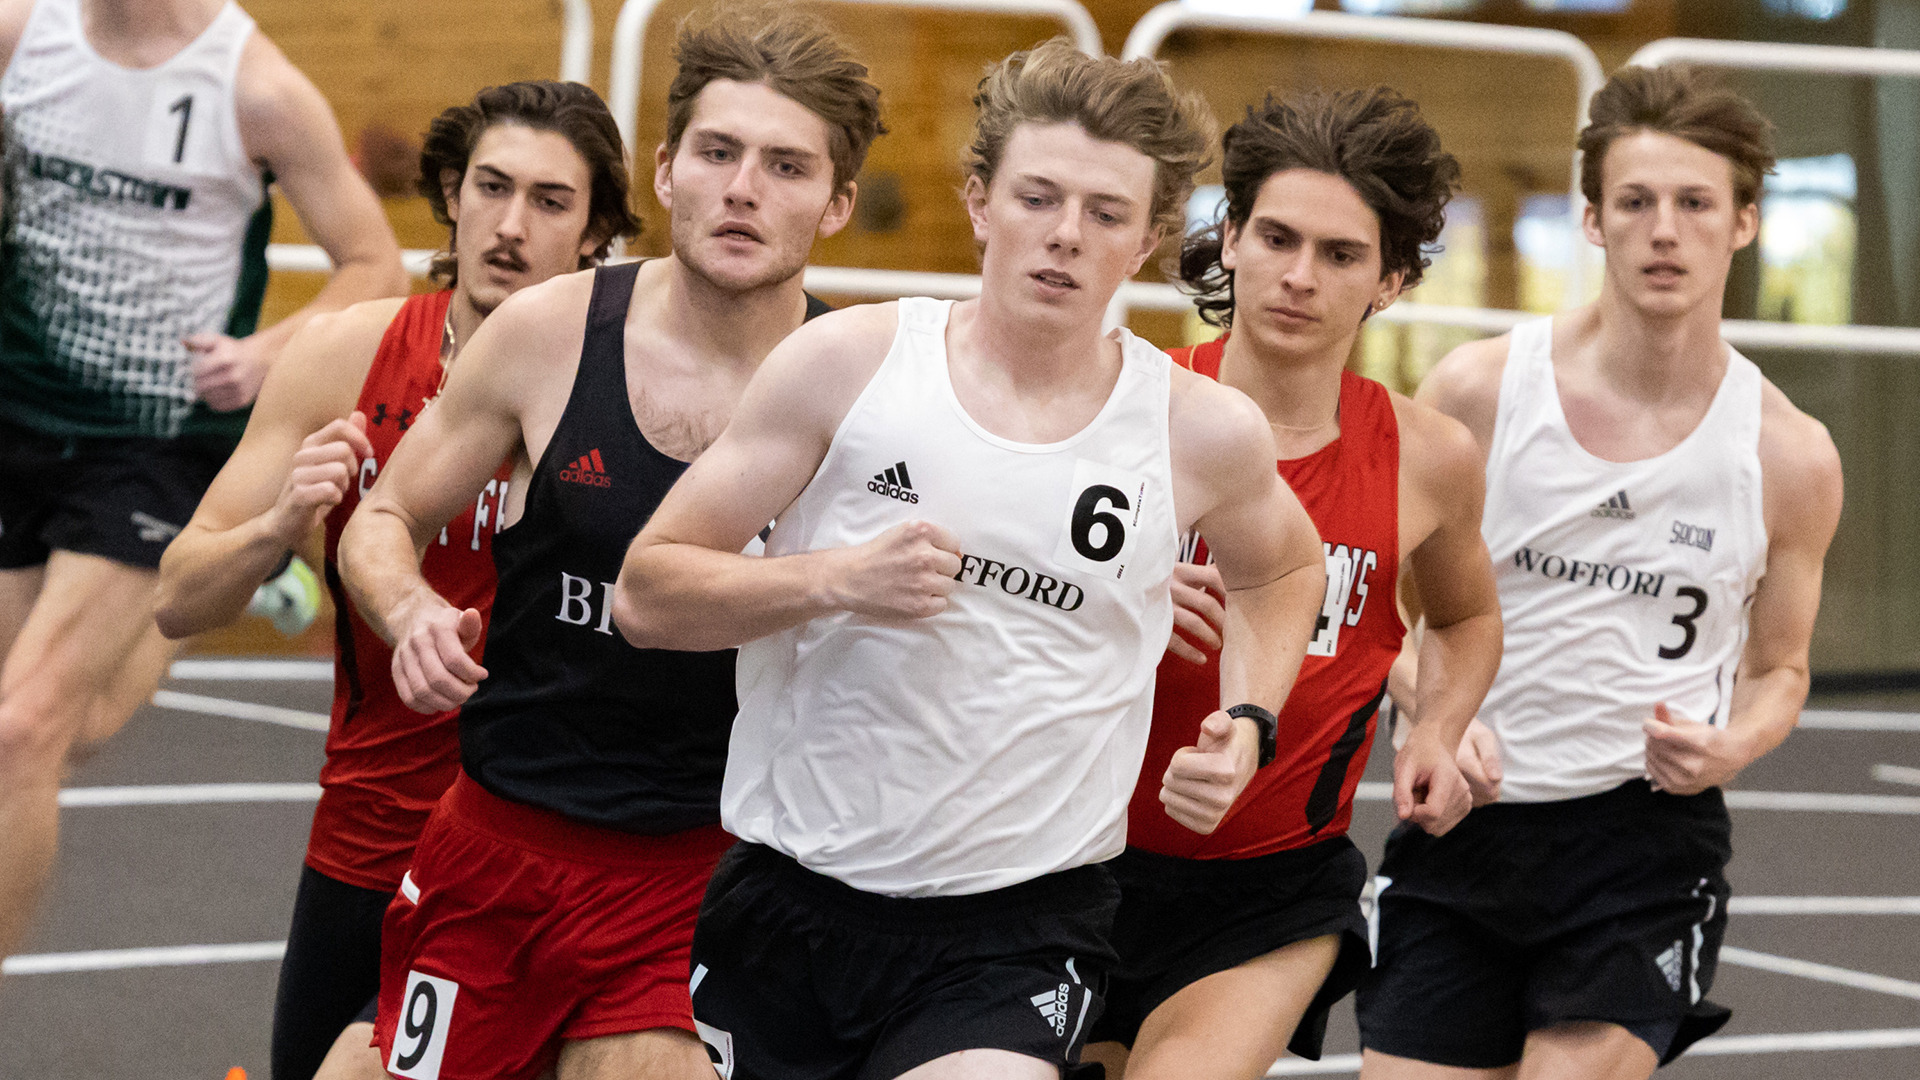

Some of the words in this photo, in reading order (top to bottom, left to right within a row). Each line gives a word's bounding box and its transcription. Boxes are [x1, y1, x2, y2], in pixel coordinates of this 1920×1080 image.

[170, 94, 194, 163] 1
[559, 467, 612, 489] adidas
[867, 478, 919, 504] adidas
[1070, 484, 1131, 562] 6
[953, 553, 1085, 612] FFORD
[1657, 585, 1709, 660] 3
[396, 980, 438, 1071] 9
[1055, 982, 1070, 1037] adidas
